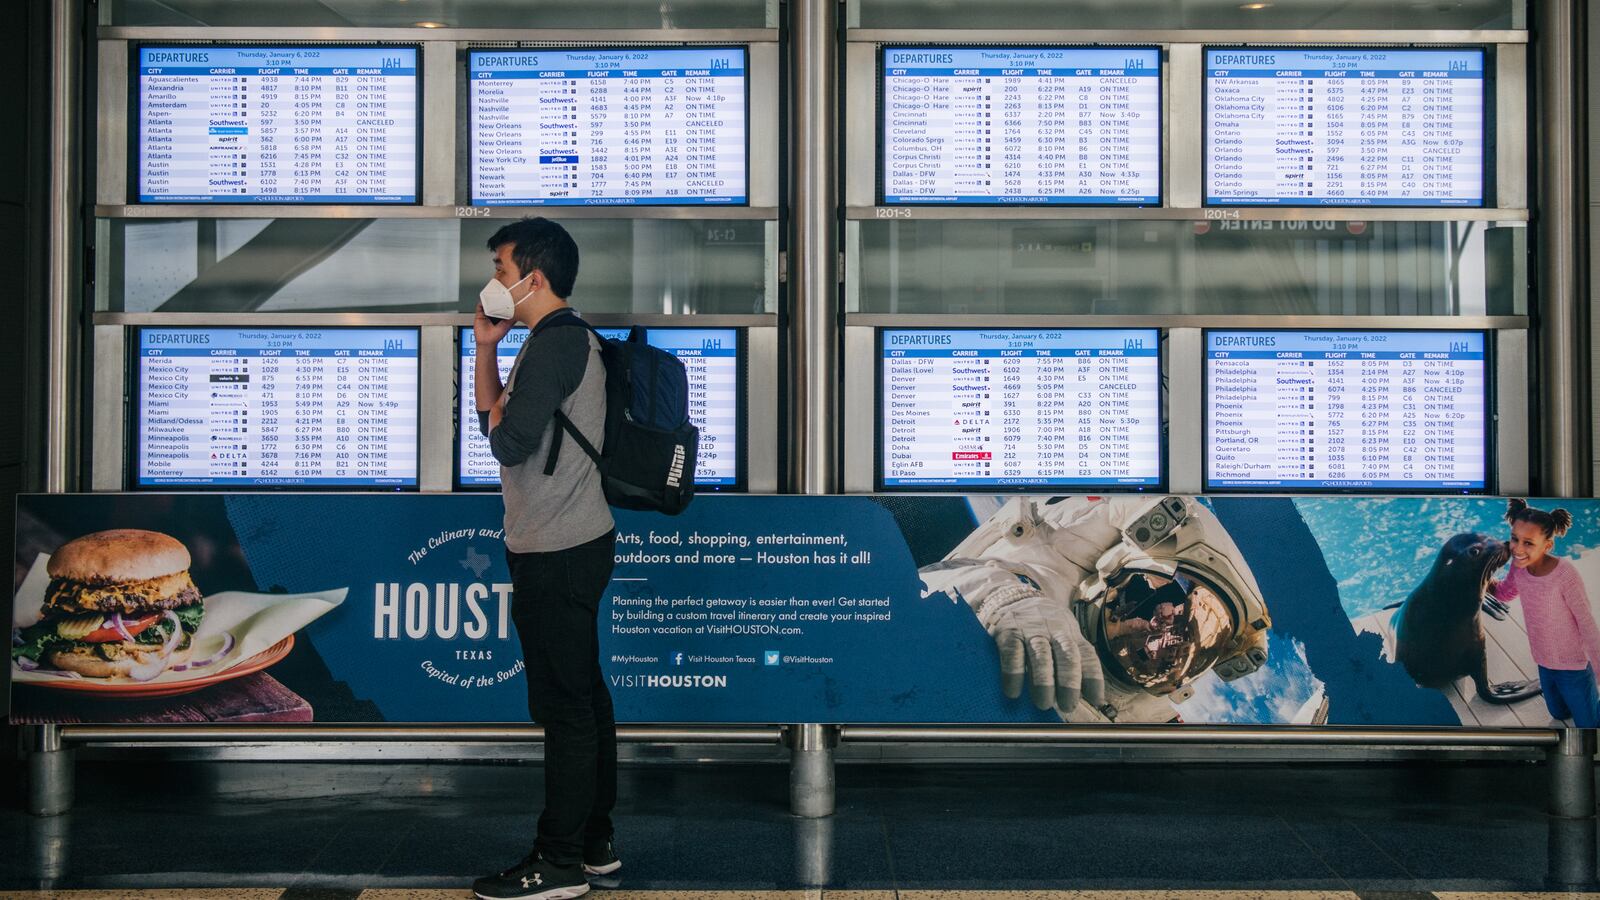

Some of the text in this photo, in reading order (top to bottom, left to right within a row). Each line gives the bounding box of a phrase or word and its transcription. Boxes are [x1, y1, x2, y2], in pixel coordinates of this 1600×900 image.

[148, 53, 208, 62] DEPARTURES
[478, 57, 538, 66] DEPARTURES
[566, 54, 597, 62] Thursday,
[893, 54, 952, 63] DEPARTURES
[1215, 56, 1275, 65] DEPARTURES
[382, 58, 400, 68] IAH
[710, 59, 729, 69] IAH
[1124, 59, 1143, 69] IAH
[1449, 61, 1468, 71] IAH
[511, 157, 526, 165] City
[1232, 189, 1258, 198] Springs
[149, 334, 210, 344] DEPARTURES
[702, 339, 721, 349] IAH
[891, 335, 951, 345] DEPARTURES
[1124, 339, 1143, 349] IAH
[1215, 337, 1275, 346] DEPARTURES
[1304, 335, 1334, 343] Thursday,
[384, 339, 403, 350] IAH
[1450, 342, 1468, 352] IAH
[148, 452, 189, 460] Minneapolis
[666, 444, 685, 487] PUMA
[615, 532, 848, 547] Arts, food, shopping, entertainment,
[408, 528, 503, 565] The Culinary and
[614, 552, 871, 564] outdoors and more Houston has it all!
[612, 596, 652, 608] Planning
[654, 597, 668, 606] the
[671, 596, 703, 608] perfect
[706, 598, 747, 608] getaway
[759, 598, 787, 606] easier
[789, 597, 809, 606] than
[812, 597, 835, 606] ever!
[838, 597, 856, 607] Get
[858, 598, 890, 607] started
[612, 611, 625, 622] by
[627, 611, 664, 622] building
[710, 611, 736, 621] travel
[738, 611, 776, 622] itinerary
[778, 611, 797, 621] and
[799, 612, 828, 621] create
[830, 614, 852, 622] your
[854, 611, 891, 622] inspired
[612, 625, 804, 635] Houston vacation at VisitHOUSTON.com.
[456, 651, 492, 660] TEXAS
[611, 655, 658, 664] #MyHouston
[688, 655, 703, 663] Visit
[704, 655, 734, 663] Houston
[783, 655, 833, 664] @VisitHouston
[421, 660, 459, 685] Capital
[460, 676, 474, 688] of
[477, 675, 493, 687] the
[611, 675, 727, 687] VISITHOUSTON
